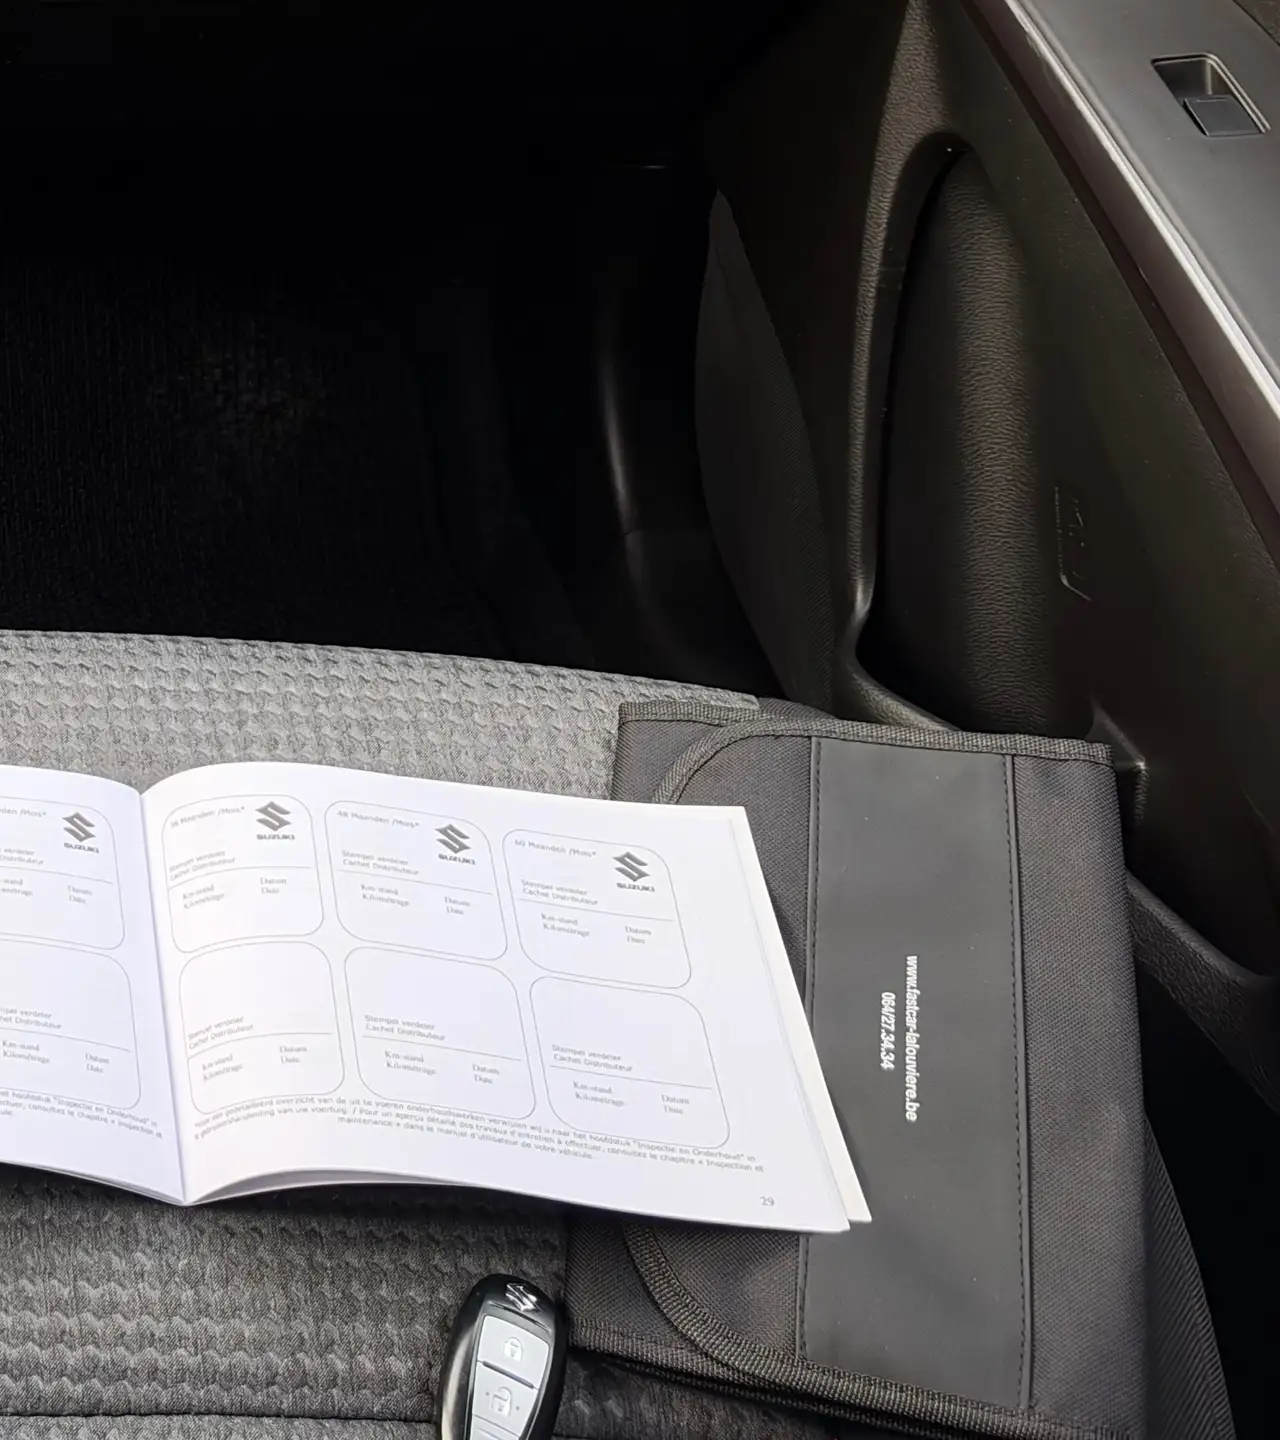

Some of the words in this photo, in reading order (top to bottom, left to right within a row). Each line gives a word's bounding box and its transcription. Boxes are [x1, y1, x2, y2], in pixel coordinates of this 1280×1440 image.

[64, 842, 100, 854] SUZUKI
[438, 853, 476, 866] SUZUKI
[616, 882, 656, 893] SUZUKI
[881, 992, 896, 1071] 064/27.34.34
[905, 956, 920, 1122] www.fastcar-lalouviere.be
[760, 1196, 775, 1207] 29
